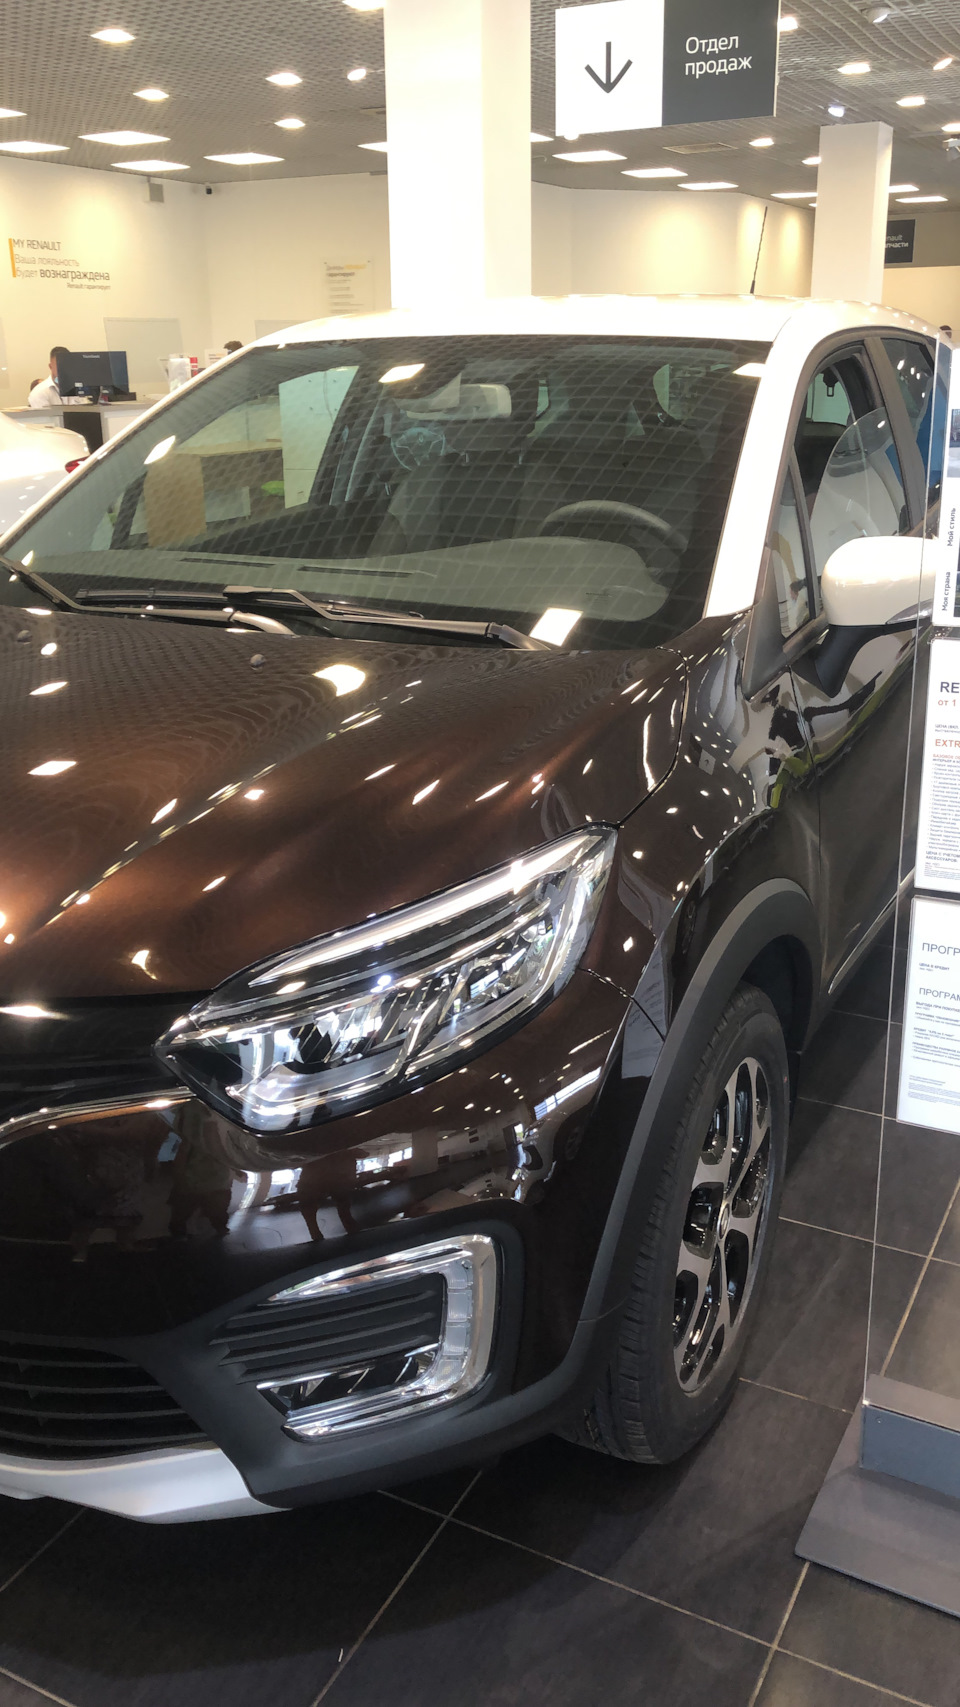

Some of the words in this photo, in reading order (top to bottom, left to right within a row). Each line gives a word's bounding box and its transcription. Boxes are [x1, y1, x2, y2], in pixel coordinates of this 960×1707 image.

[685, 36, 739, 55] Отдел
[685, 56, 752, 79] продаж
[13, 239, 25, 248] MY
[26, 240, 61, 251] RENAULT
[15, 254, 37, 264] Ваша
[38, 257, 80, 267] лояльность
[16, 267, 38, 279] будет
[40, 269, 110, 282] вознаграждена
[948, 508, 956, 529] стиль
[946, 530, 954, 547] Мой
[943, 572, 952, 595] страна
[941, 596, 949, 611] Моя
[938, 699, 949, 707] от
